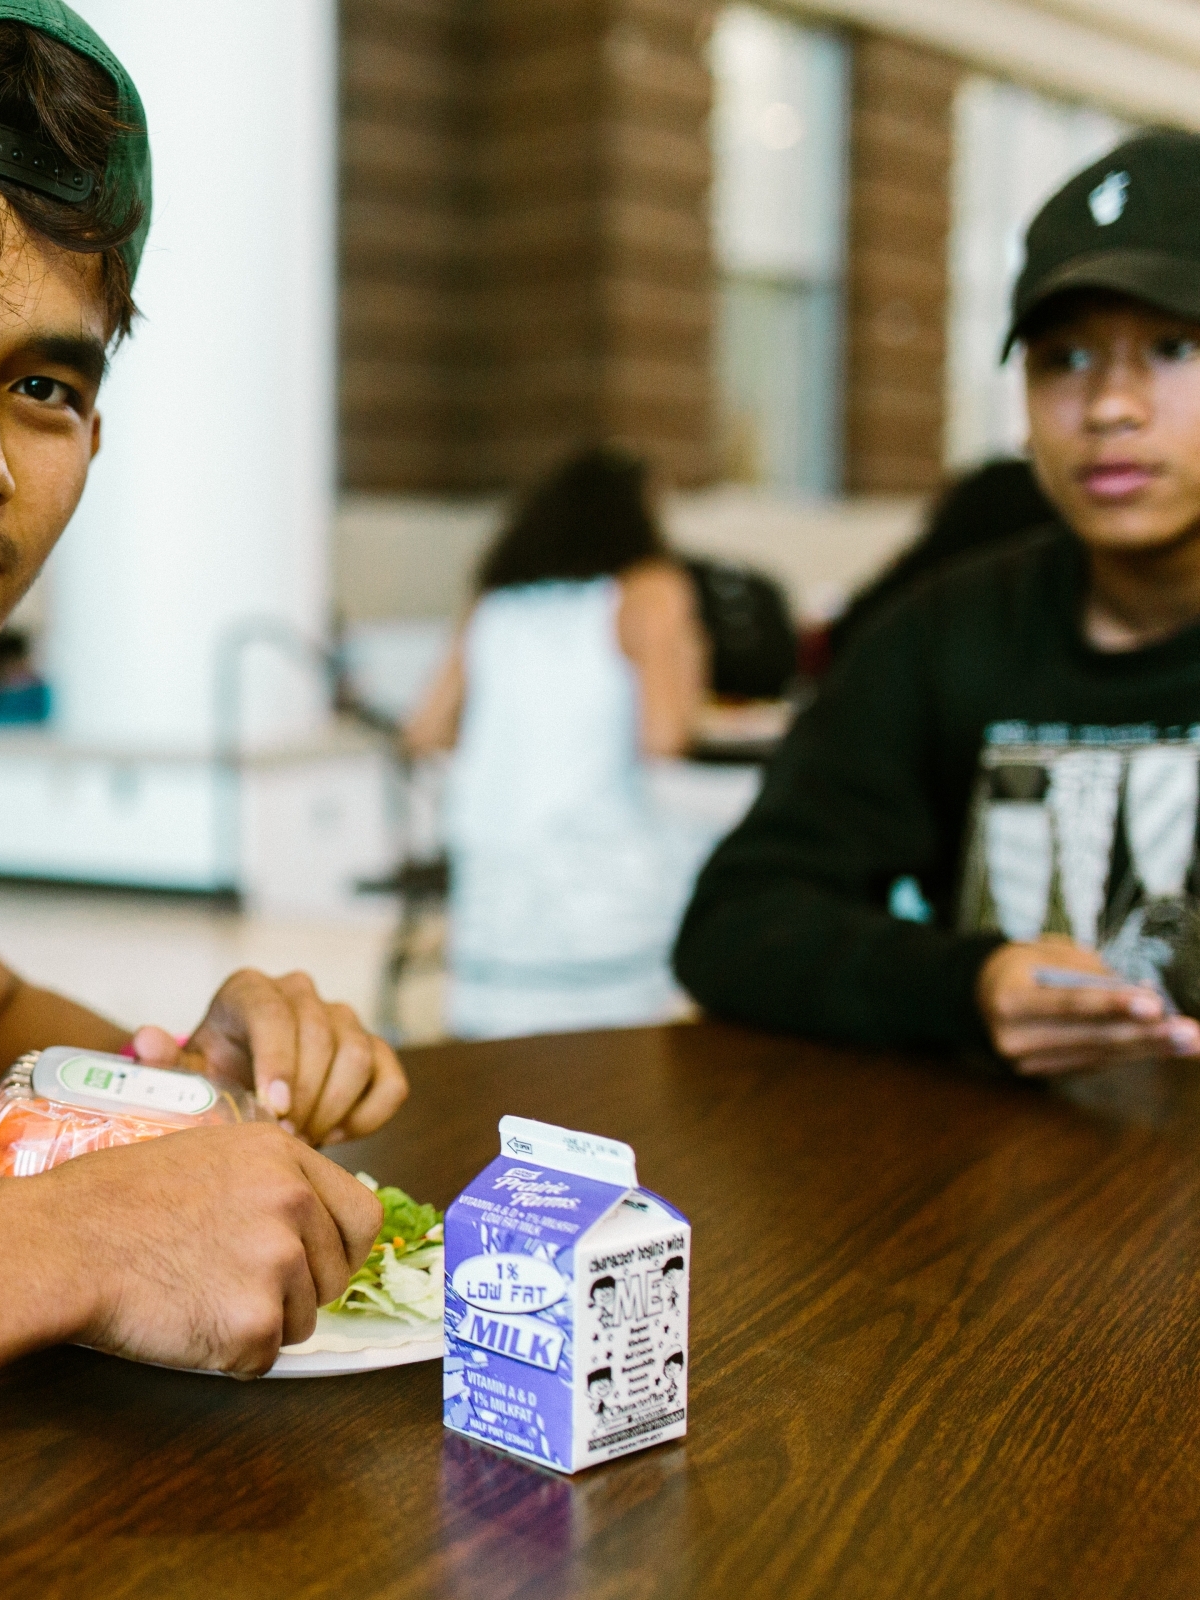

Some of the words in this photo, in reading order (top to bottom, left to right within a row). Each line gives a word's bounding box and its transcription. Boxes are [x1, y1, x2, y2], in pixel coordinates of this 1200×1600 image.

[520, 1142, 530, 1151] OPEN
[492, 1176, 570, 1195] Prairie
[458, 1194, 495, 1211] VITAMIN
[509, 1192, 581, 1210] Farms
[481, 1211, 502, 1225] LOW
[501, 1214, 520, 1230] FAT
[518, 1220, 543, 1237] MILK
[497, 1262, 519, 1281] 1%
[467, 1280, 502, 1301] LOW
[511, 1284, 547, 1304] FAT
[612, 1268, 664, 1329] ME
[469, 1313, 555, 1366] MILK
[467, 1369, 507, 1397] VITAMIN
[508, 1384, 516, 1401] A
[517, 1387, 527, 1405] &
[527, 1391, 537, 1408] D
[473, 1390, 489, 1408] 1%
[490, 1395, 534, 1424] MILKFAT
[469, 1417, 487, 1433] HALF
[487, 1423, 504, 1440] PINT
